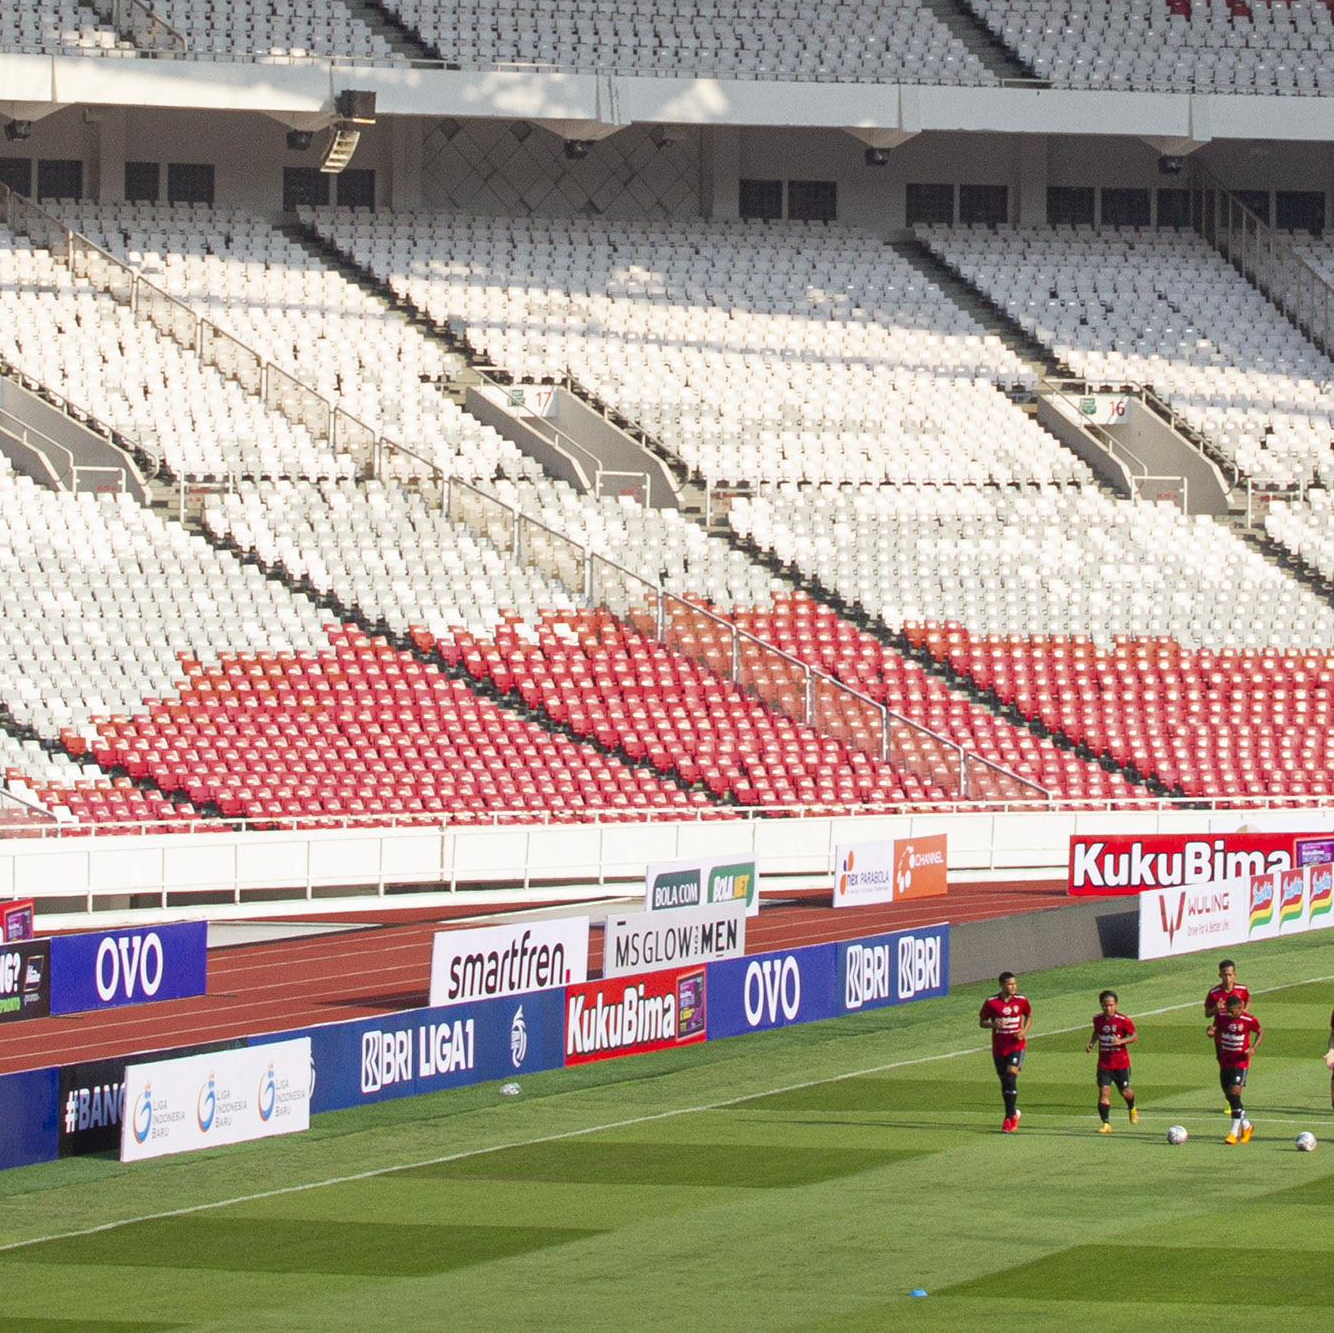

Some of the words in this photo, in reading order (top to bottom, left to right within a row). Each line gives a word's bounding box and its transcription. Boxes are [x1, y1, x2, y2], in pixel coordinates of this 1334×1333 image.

[536, 391, 552, 408] 17
[1109, 401, 1125, 416] 16
[915, 851, 943, 866] CHANNEL
[1073, 840, 1291, 887] KukuBima
[860, 870, 889, 885] PARABOLA
[1188, 892, 1230, 916] WULING
[616, 933, 640, 968] MS
[643, 926, 693, 964] GLOW
[701, 919, 737, 954] MEN
[96, 932, 163, 1001] OVO
[915, 936, 941, 991] BRI
[863, 945, 889, 1001] BRI
[744, 955, 801, 1027] OVO
[567, 982, 676, 1056] KukuBima
[382, 1029, 413, 1086] BRI
[276, 1079, 289, 1090] LIGA
[216, 1090, 230, 1100] LIGA
[275, 1089, 306, 1104] INDONESIA
[153, 1100, 167, 1111] LIGA
[216, 1100, 248, 1115] INDONESIA
[275, 1106, 291, 1117] BARU
[152, 1111, 185, 1124] INDONESIA
[215, 1116, 231, 1128] BARU
[152, 1128, 169, 1139] BARU
